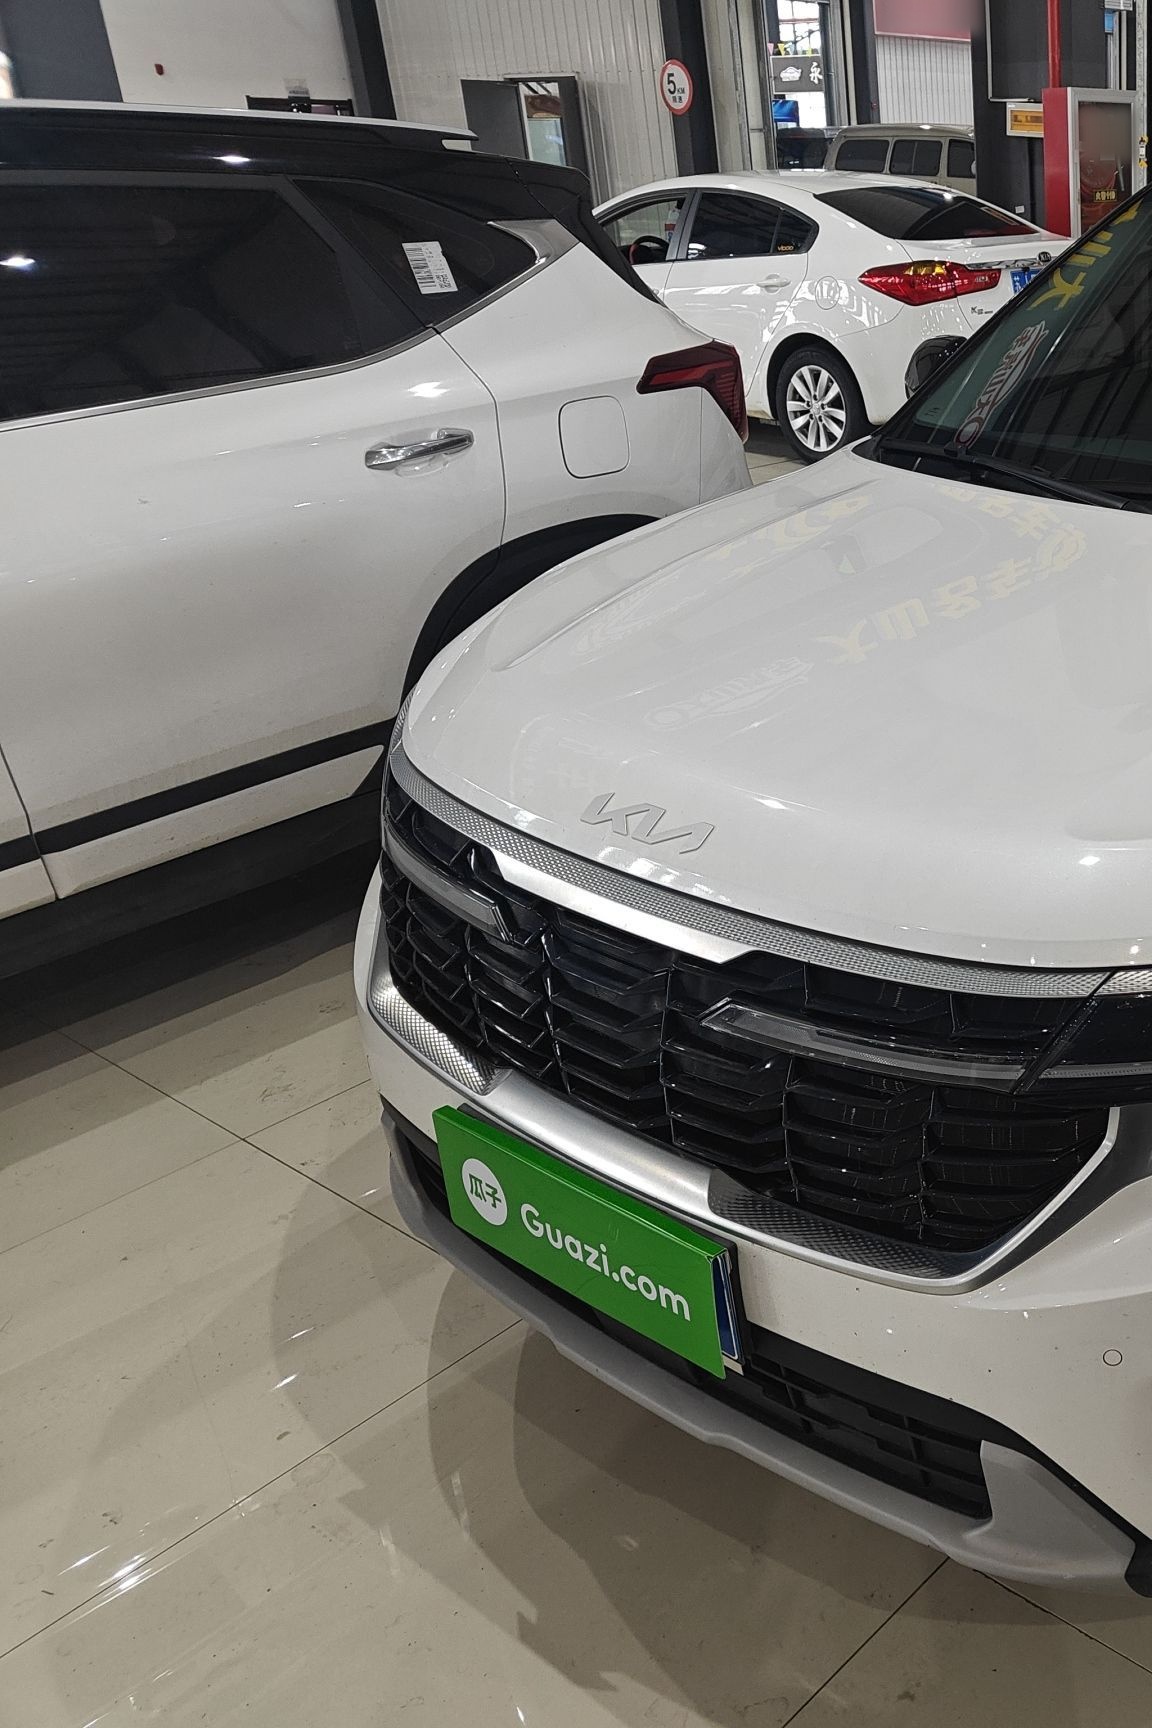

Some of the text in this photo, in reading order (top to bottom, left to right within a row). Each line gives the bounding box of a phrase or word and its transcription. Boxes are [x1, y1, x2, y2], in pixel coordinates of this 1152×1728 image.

[667, 72, 676, 95] 5
[580, 792, 715, 854] KIA
[468, 1173, 502, 1209] 瓜子
[520, 1202, 691, 1322] Guazi.com
